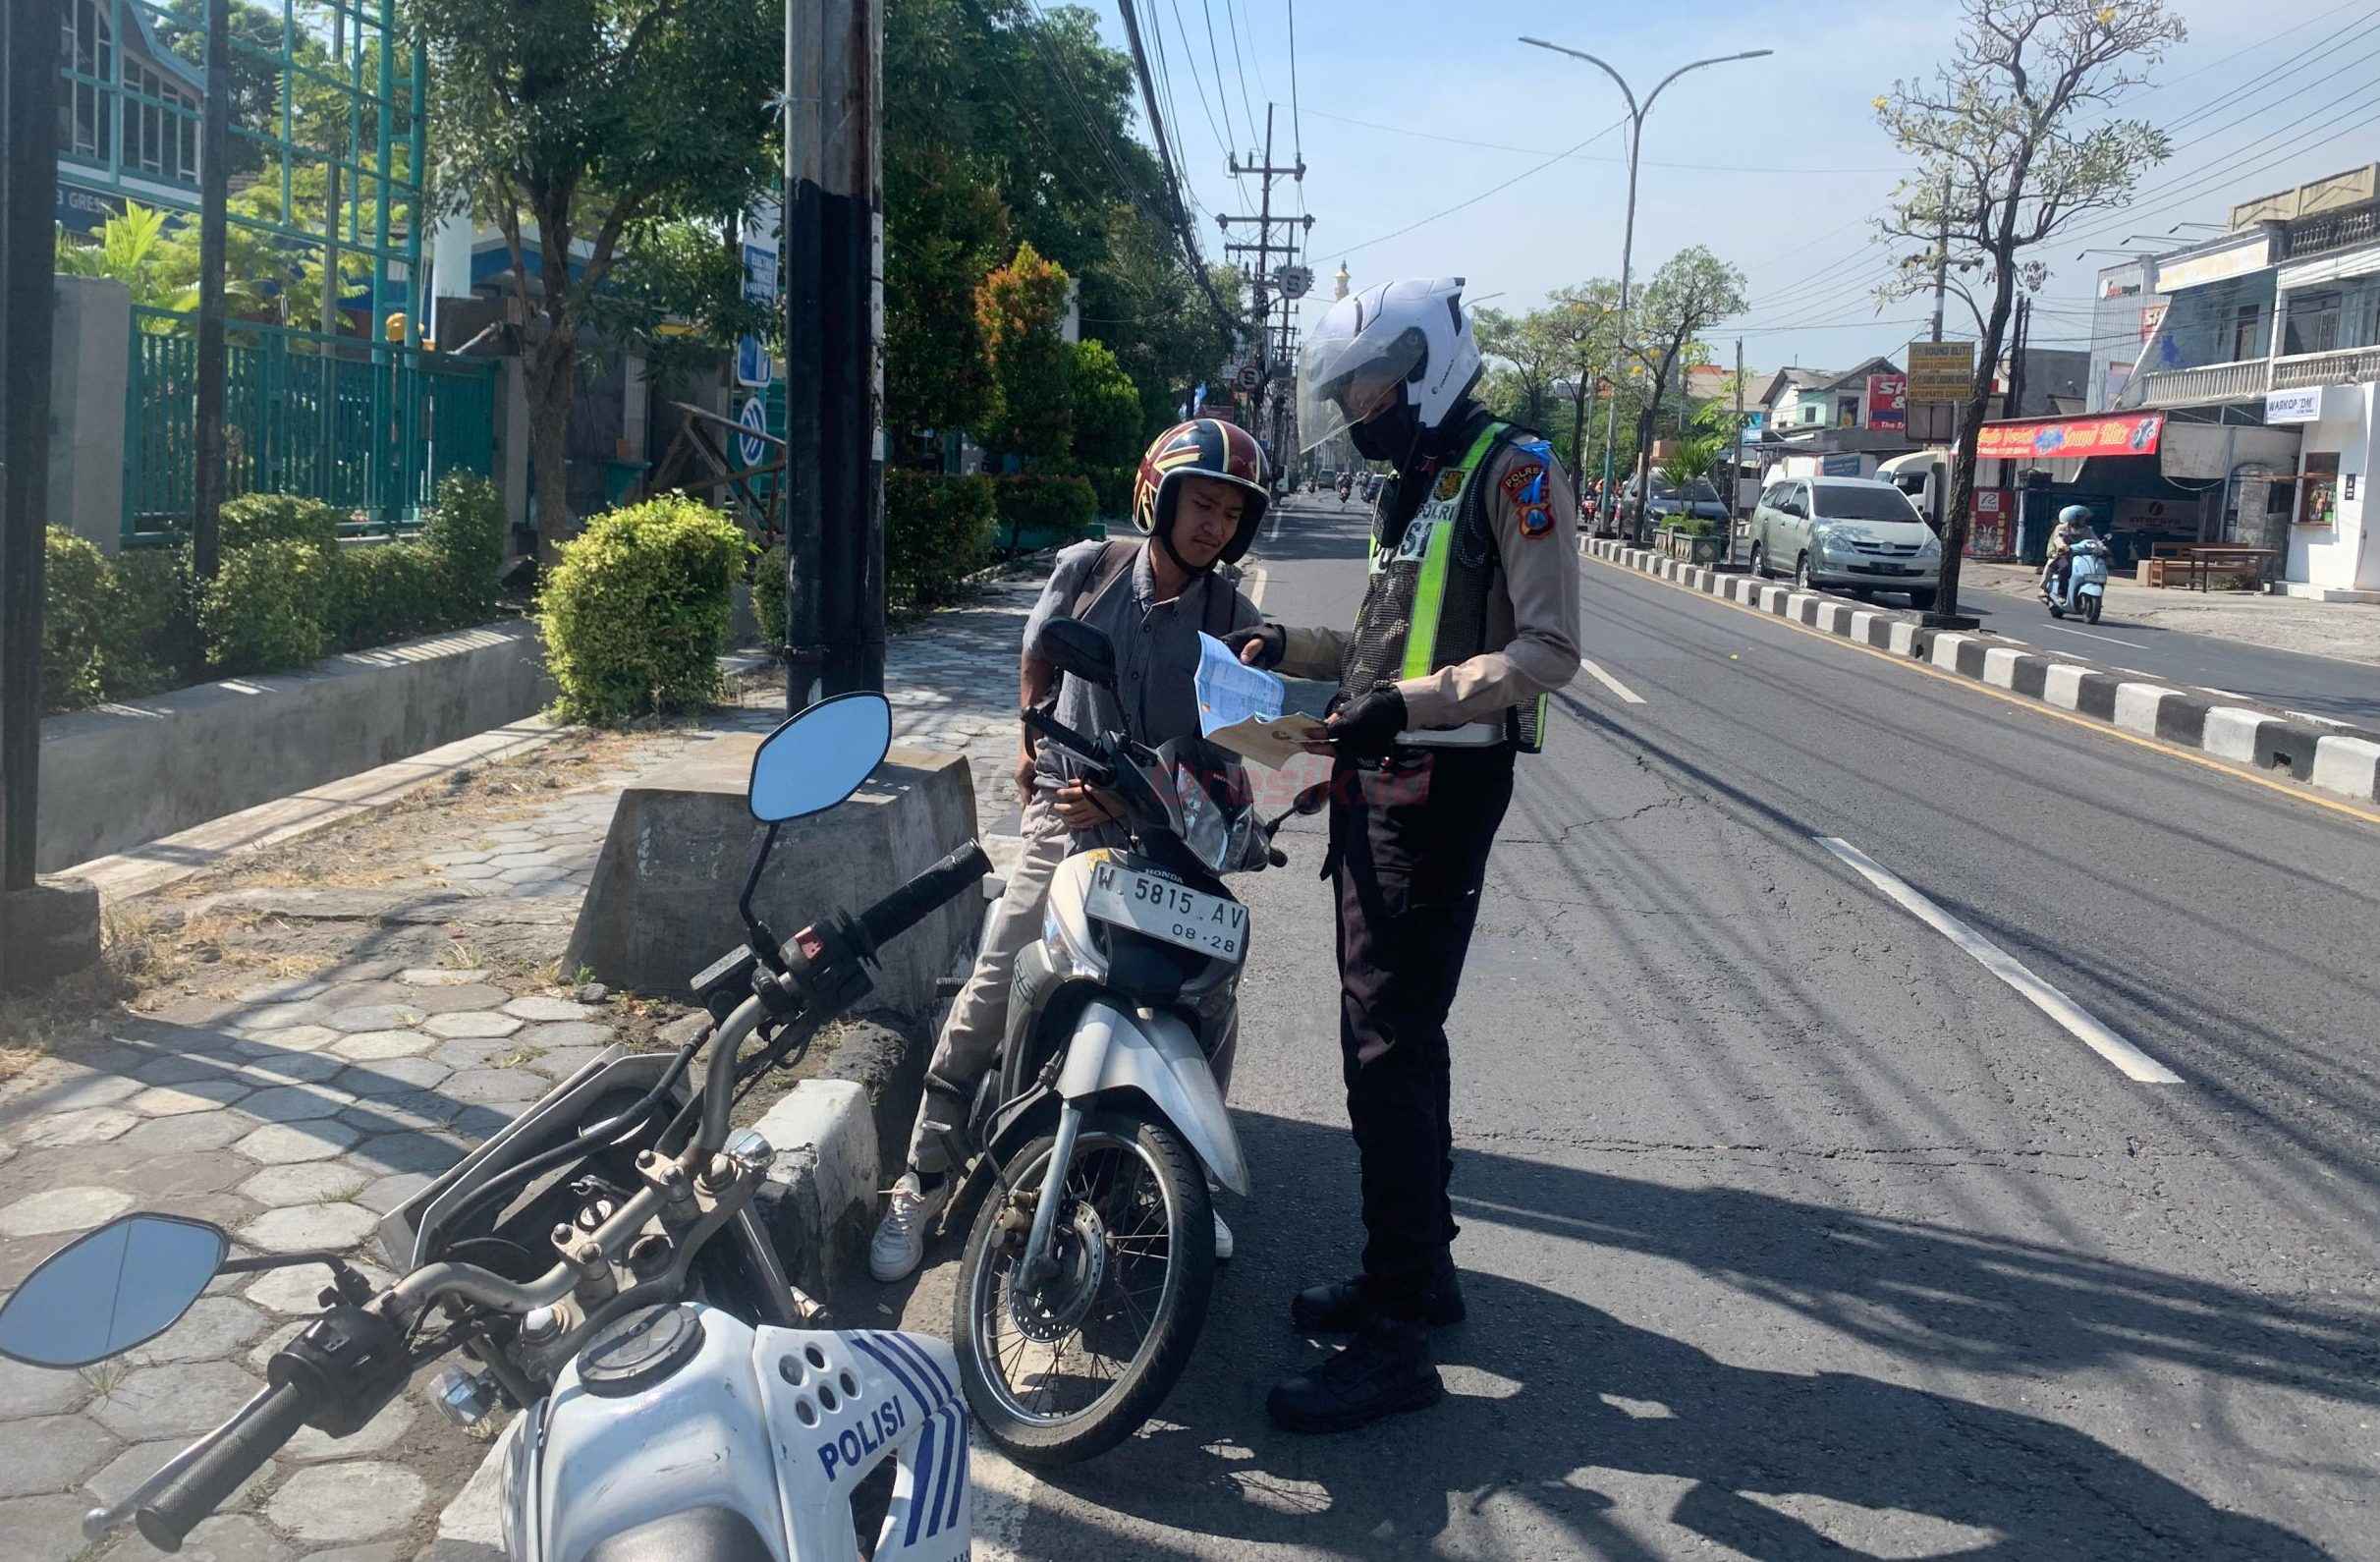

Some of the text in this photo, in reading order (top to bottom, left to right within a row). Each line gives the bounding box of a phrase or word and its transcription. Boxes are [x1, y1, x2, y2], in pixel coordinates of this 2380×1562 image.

[1505, 466, 1541, 488] POLRE
[1145, 867, 1184, 884] HONDA
[1098, 866, 1244, 928] W 5815 AV
[817, 1395, 906, 1482] POLISI
